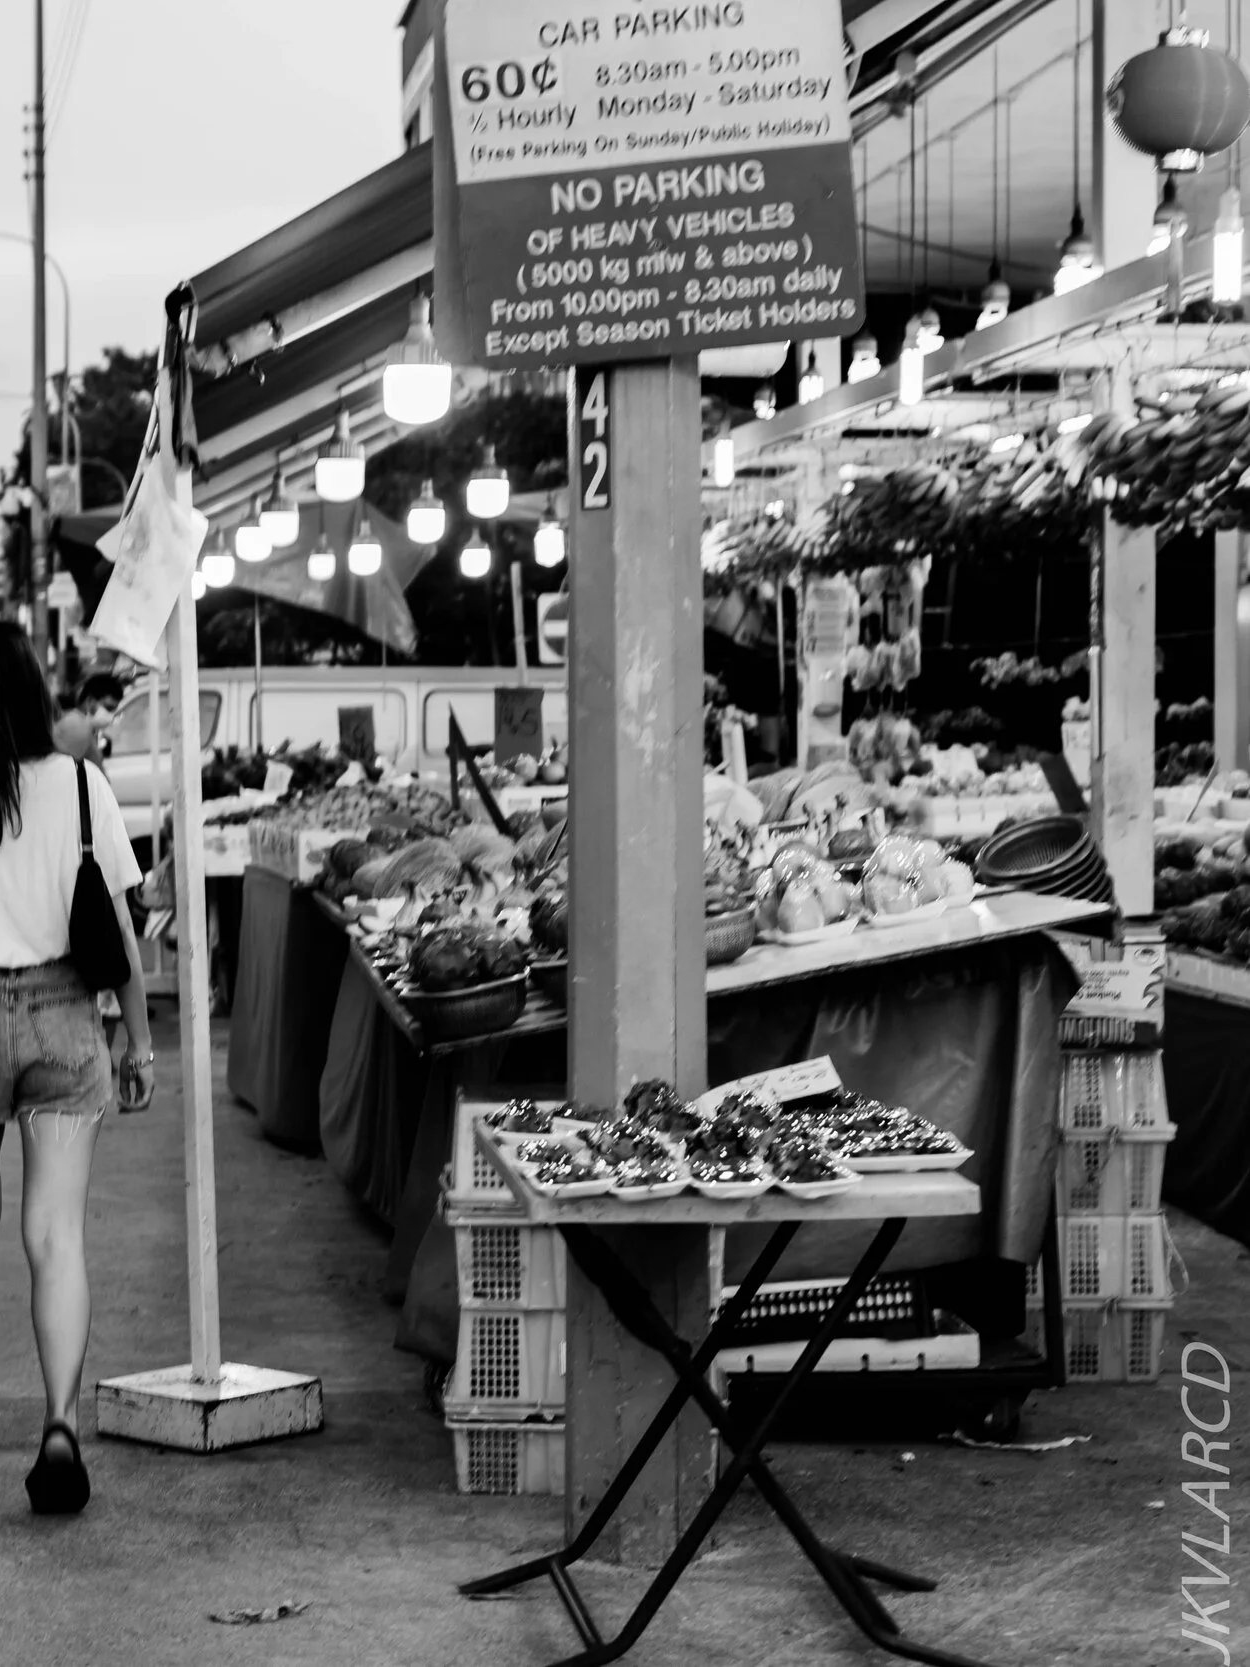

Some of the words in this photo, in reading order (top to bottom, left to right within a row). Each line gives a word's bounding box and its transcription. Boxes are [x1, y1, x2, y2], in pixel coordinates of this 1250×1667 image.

[539, 17, 600, 48] CAR
[614, 1, 744, 40] PARKING
[461, 55, 558, 103] 60¢
[595, 59, 687, 88] 8.30am
[708, 47, 800, 75] 5.00pm
[498, 101, 577, 131] Hourly
[598, 90, 696, 120] Monday
[718, 76, 831, 106] Saturday
[470, 144, 516, 166] (Free
[522, 139, 588, 159] Parking
[595, 135, 619, 153] On
[625, 122, 751, 149] Sunday/Public
[757, 112, 831, 139] Holiday)
[551, 178, 602, 215] NO
[614, 159, 765, 208] PARKING
[526, 227, 564, 256] OF
[570, 216, 658, 251] HEAVY
[666, 201, 795, 240] VEHICLES
[600, 255, 630, 285] kg
[694, 244, 715, 270] &
[490, 298, 554, 326] From
[561, 286, 660, 317] 10.00pm
[684, 275, 776, 304] 8.30am
[783, 264, 842, 295] daily
[485, 325, 570, 357] Except
[576, 317, 670, 347] Season
[676, 305, 753, 336] Ticket
[758, 297, 856, 328] Holders
